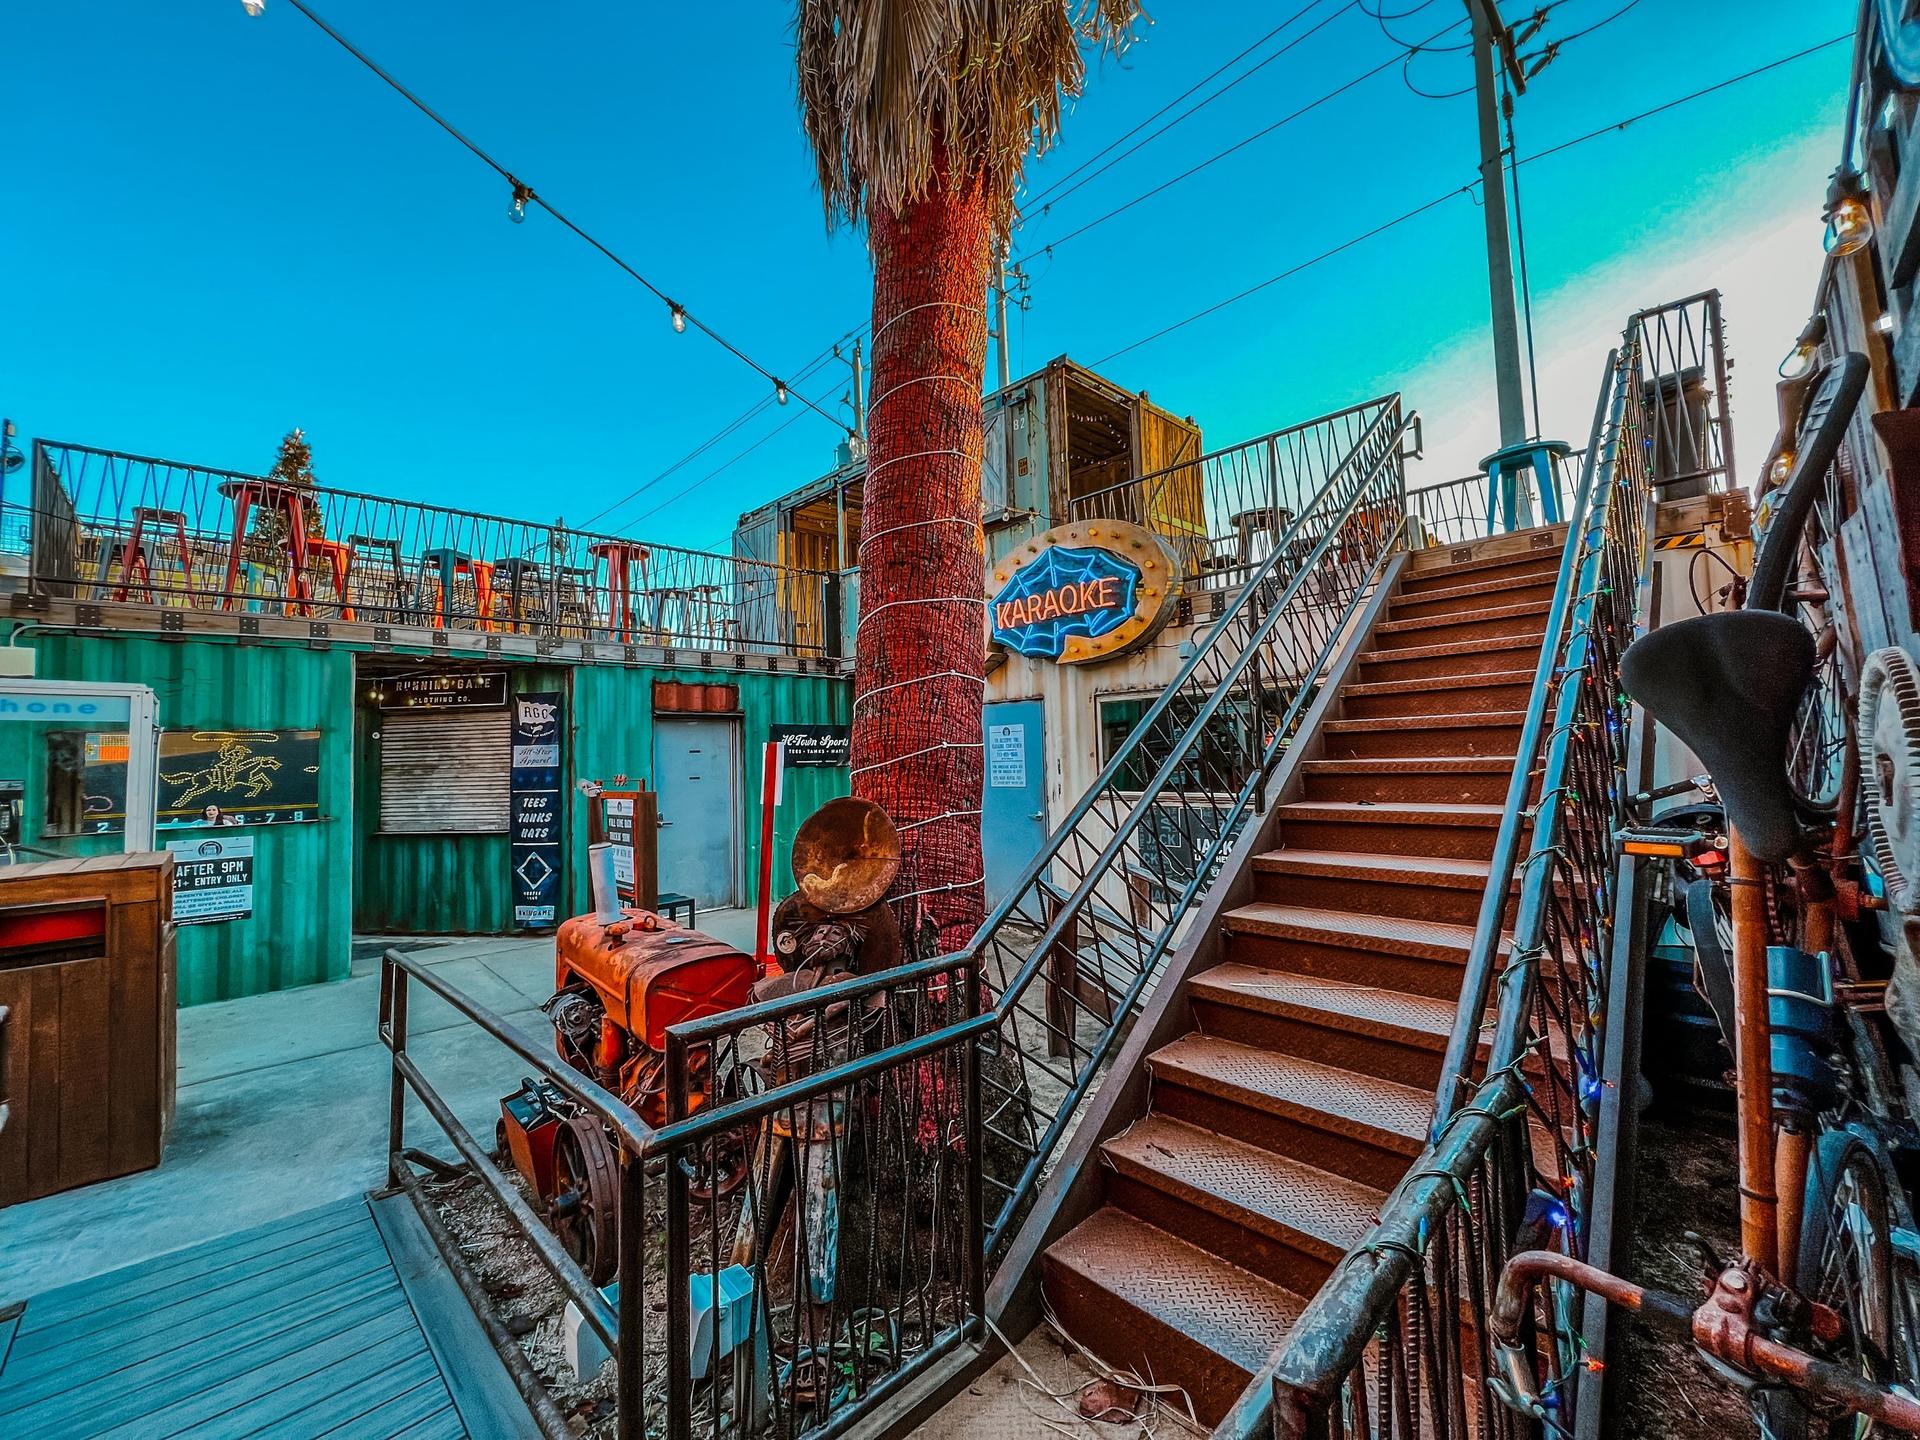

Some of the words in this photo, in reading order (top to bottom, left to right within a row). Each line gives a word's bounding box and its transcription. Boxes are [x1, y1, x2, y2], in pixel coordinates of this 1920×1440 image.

[1013, 417, 1025, 431] 82
[996, 577, 1120, 630] KARAOKE
[396, 680, 450, 692] RUNNING
[413, 696, 453, 704] CLOTHING
[524, 706, 548, 719] RGC
[781, 734, 817, 747] H-Town
[819, 734, 849, 749] Sports
[523, 797, 548, 808] TEES
[518, 812, 553, 823] TANKS
[521, 827, 549, 838] HATS
[1193, 838, 1234, 856] JAK
[176, 863, 214, 877] AFTER
[221, 860, 244, 873] 9PM
[194, 875, 222, 887] ENTRY
[226, 873, 248, 883] ONLY
